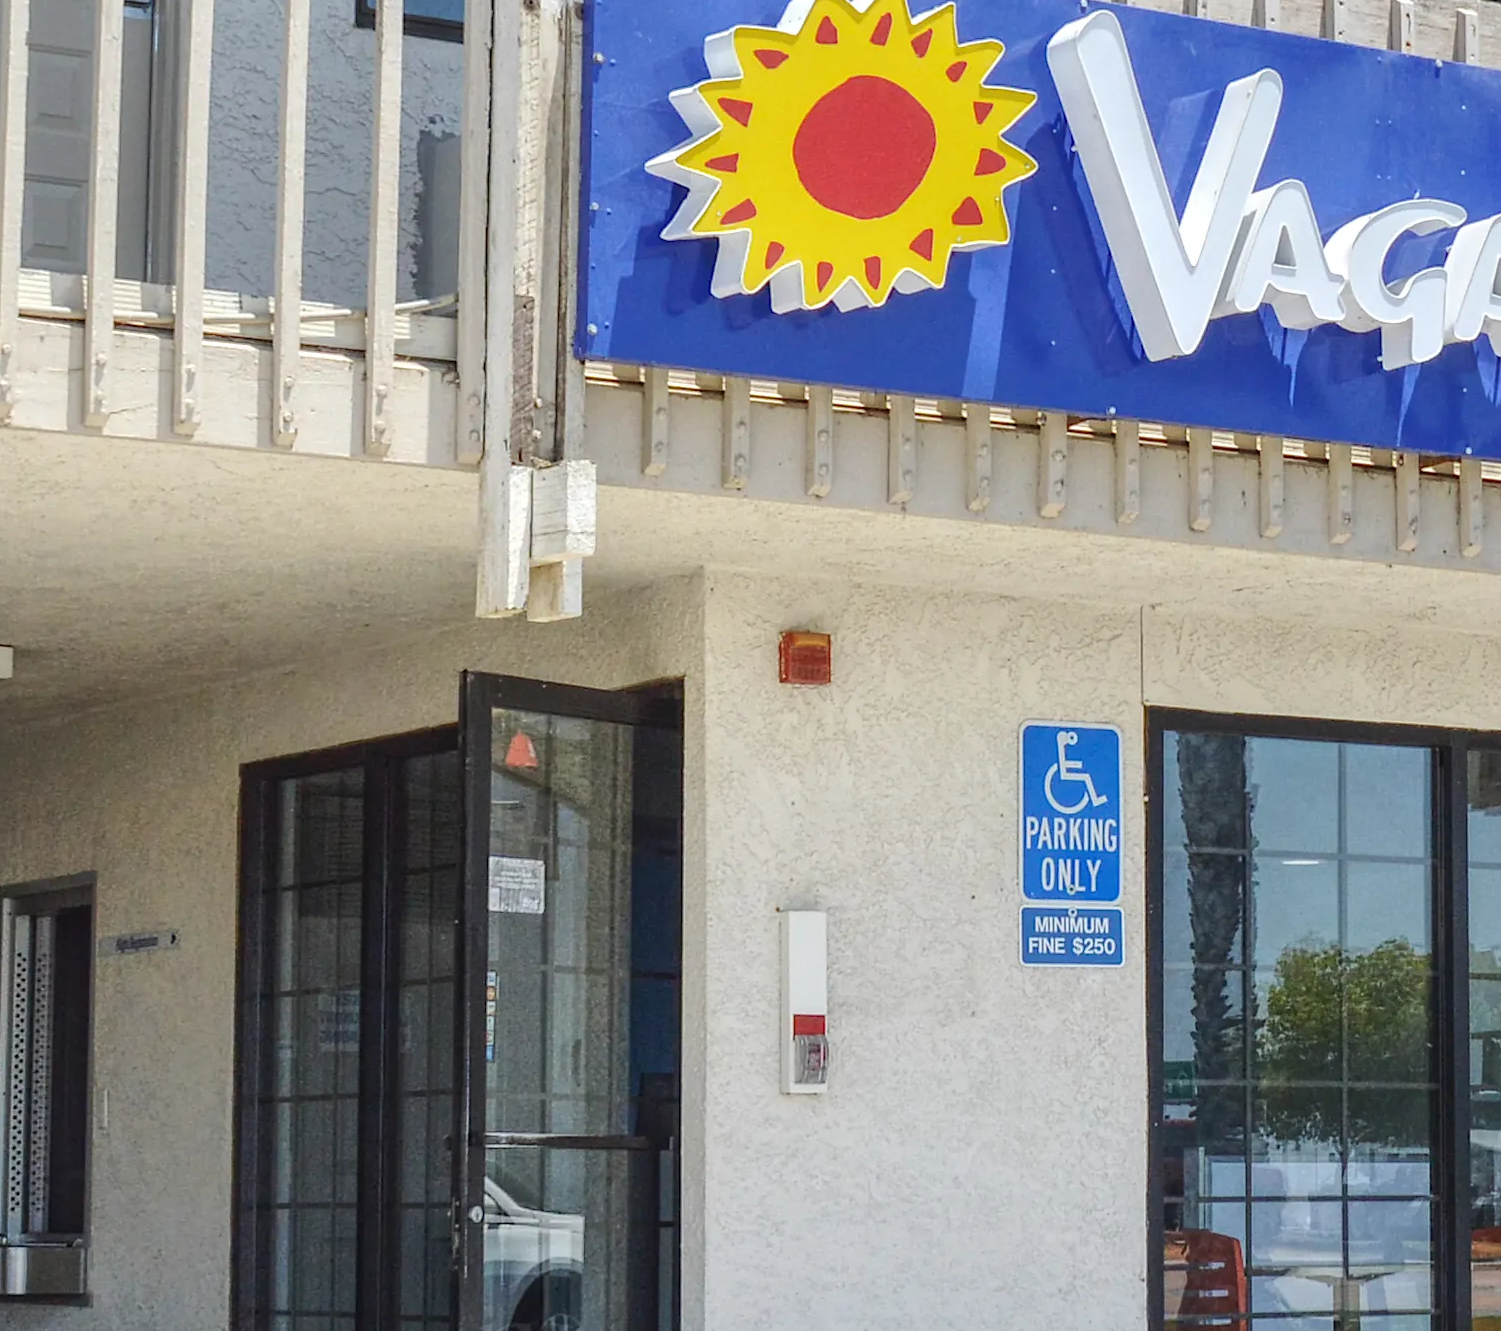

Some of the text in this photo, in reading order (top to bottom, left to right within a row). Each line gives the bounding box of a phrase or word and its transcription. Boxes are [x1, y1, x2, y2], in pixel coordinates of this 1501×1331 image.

[1025, 817, 1118, 852] PARKING
[1040, 857, 1102, 893] ONLY
[1034, 916, 1110, 935] MINIMUM
[1028, 937, 1117, 956] FINE $250
